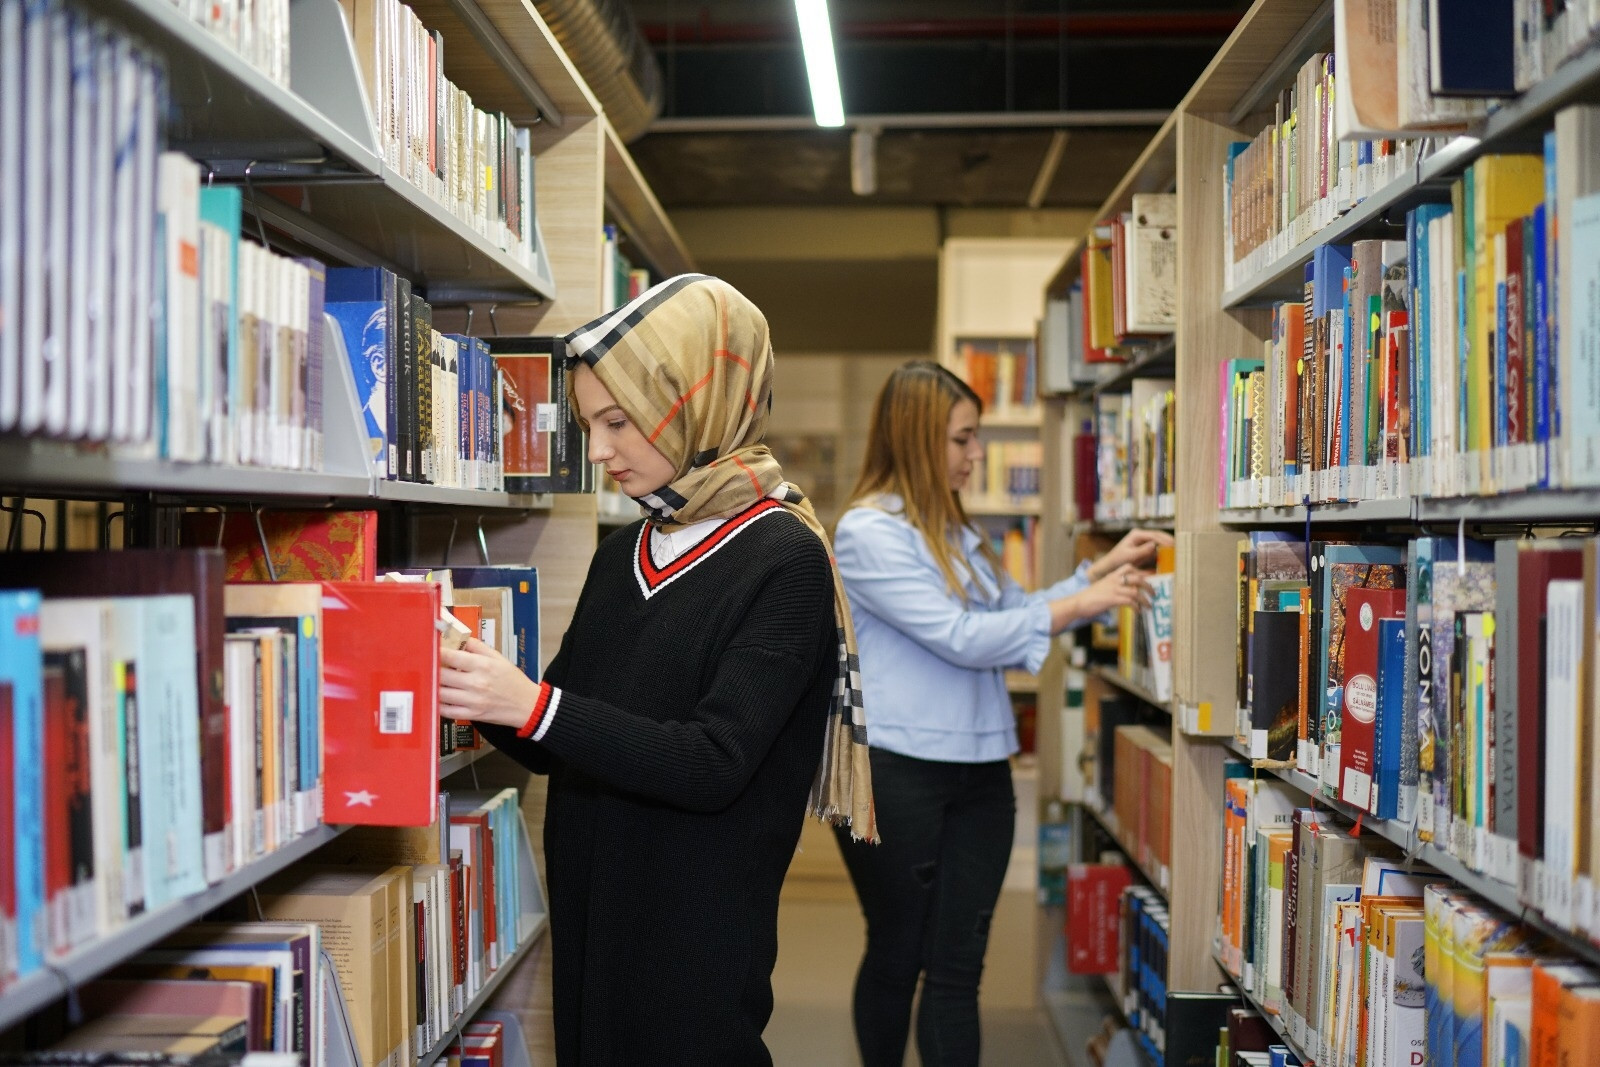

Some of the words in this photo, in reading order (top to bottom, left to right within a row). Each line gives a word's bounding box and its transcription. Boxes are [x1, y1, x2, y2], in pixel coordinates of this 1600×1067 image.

[402, 288, 411, 376] Atatürk
[417, 331, 426, 442] Atatürk
[1348, 401, 1356, 462] ENVANTERİ
[1326, 678, 1339, 746] BOLU
[1419, 621, 1433, 753] KONYA
[1502, 708, 1516, 818] MALATYA
